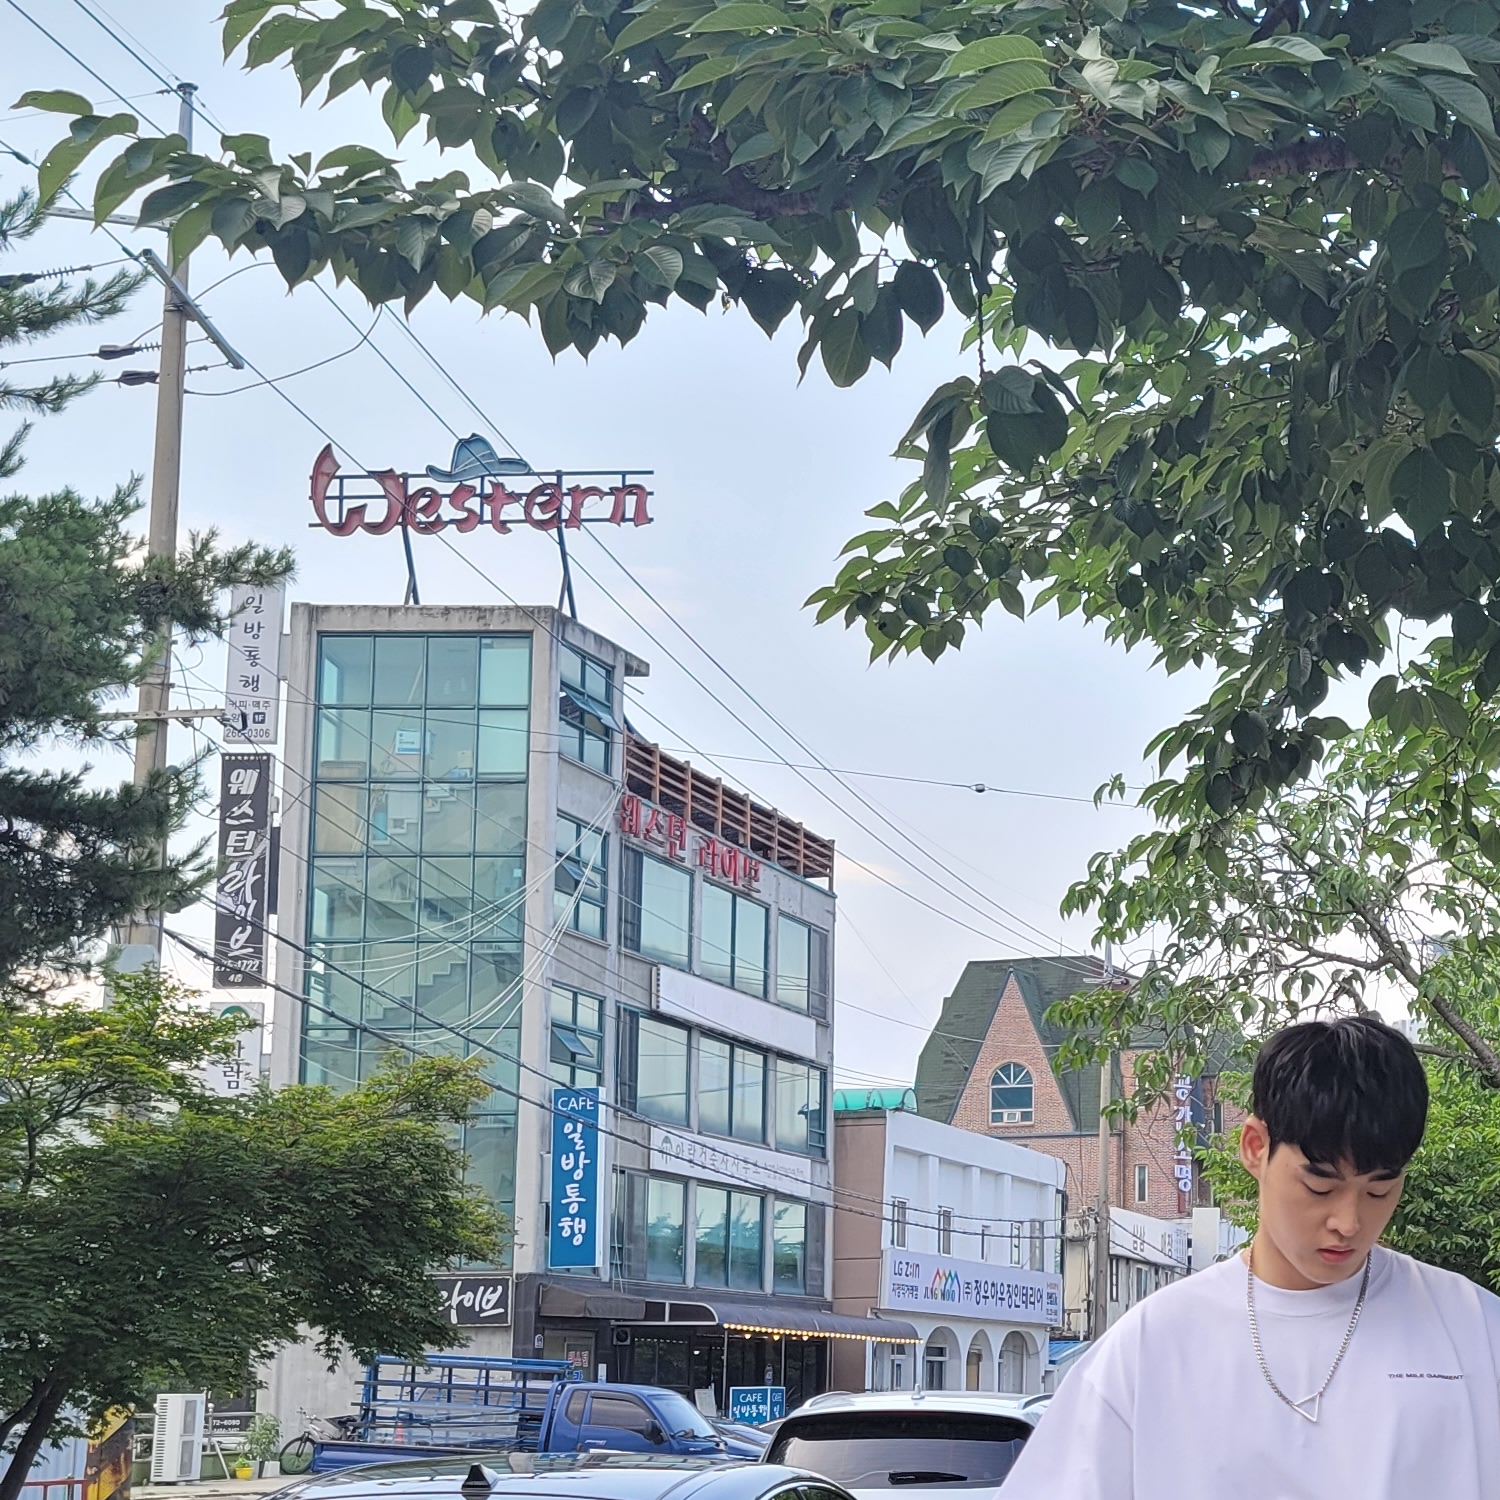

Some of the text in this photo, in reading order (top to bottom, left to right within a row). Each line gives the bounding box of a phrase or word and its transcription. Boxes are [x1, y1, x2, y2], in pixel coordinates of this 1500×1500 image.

[311, 443, 651, 537] Western
[239, 594, 265, 692] 일방통행
[621, 795, 686, 863] 웨스턴
[557, 1097, 595, 1111] CAFE
[558, 1119, 591, 1246] 일방통행
[893, 1260, 903, 1277] LG
[739, 1393, 763, 1403] CAFE
